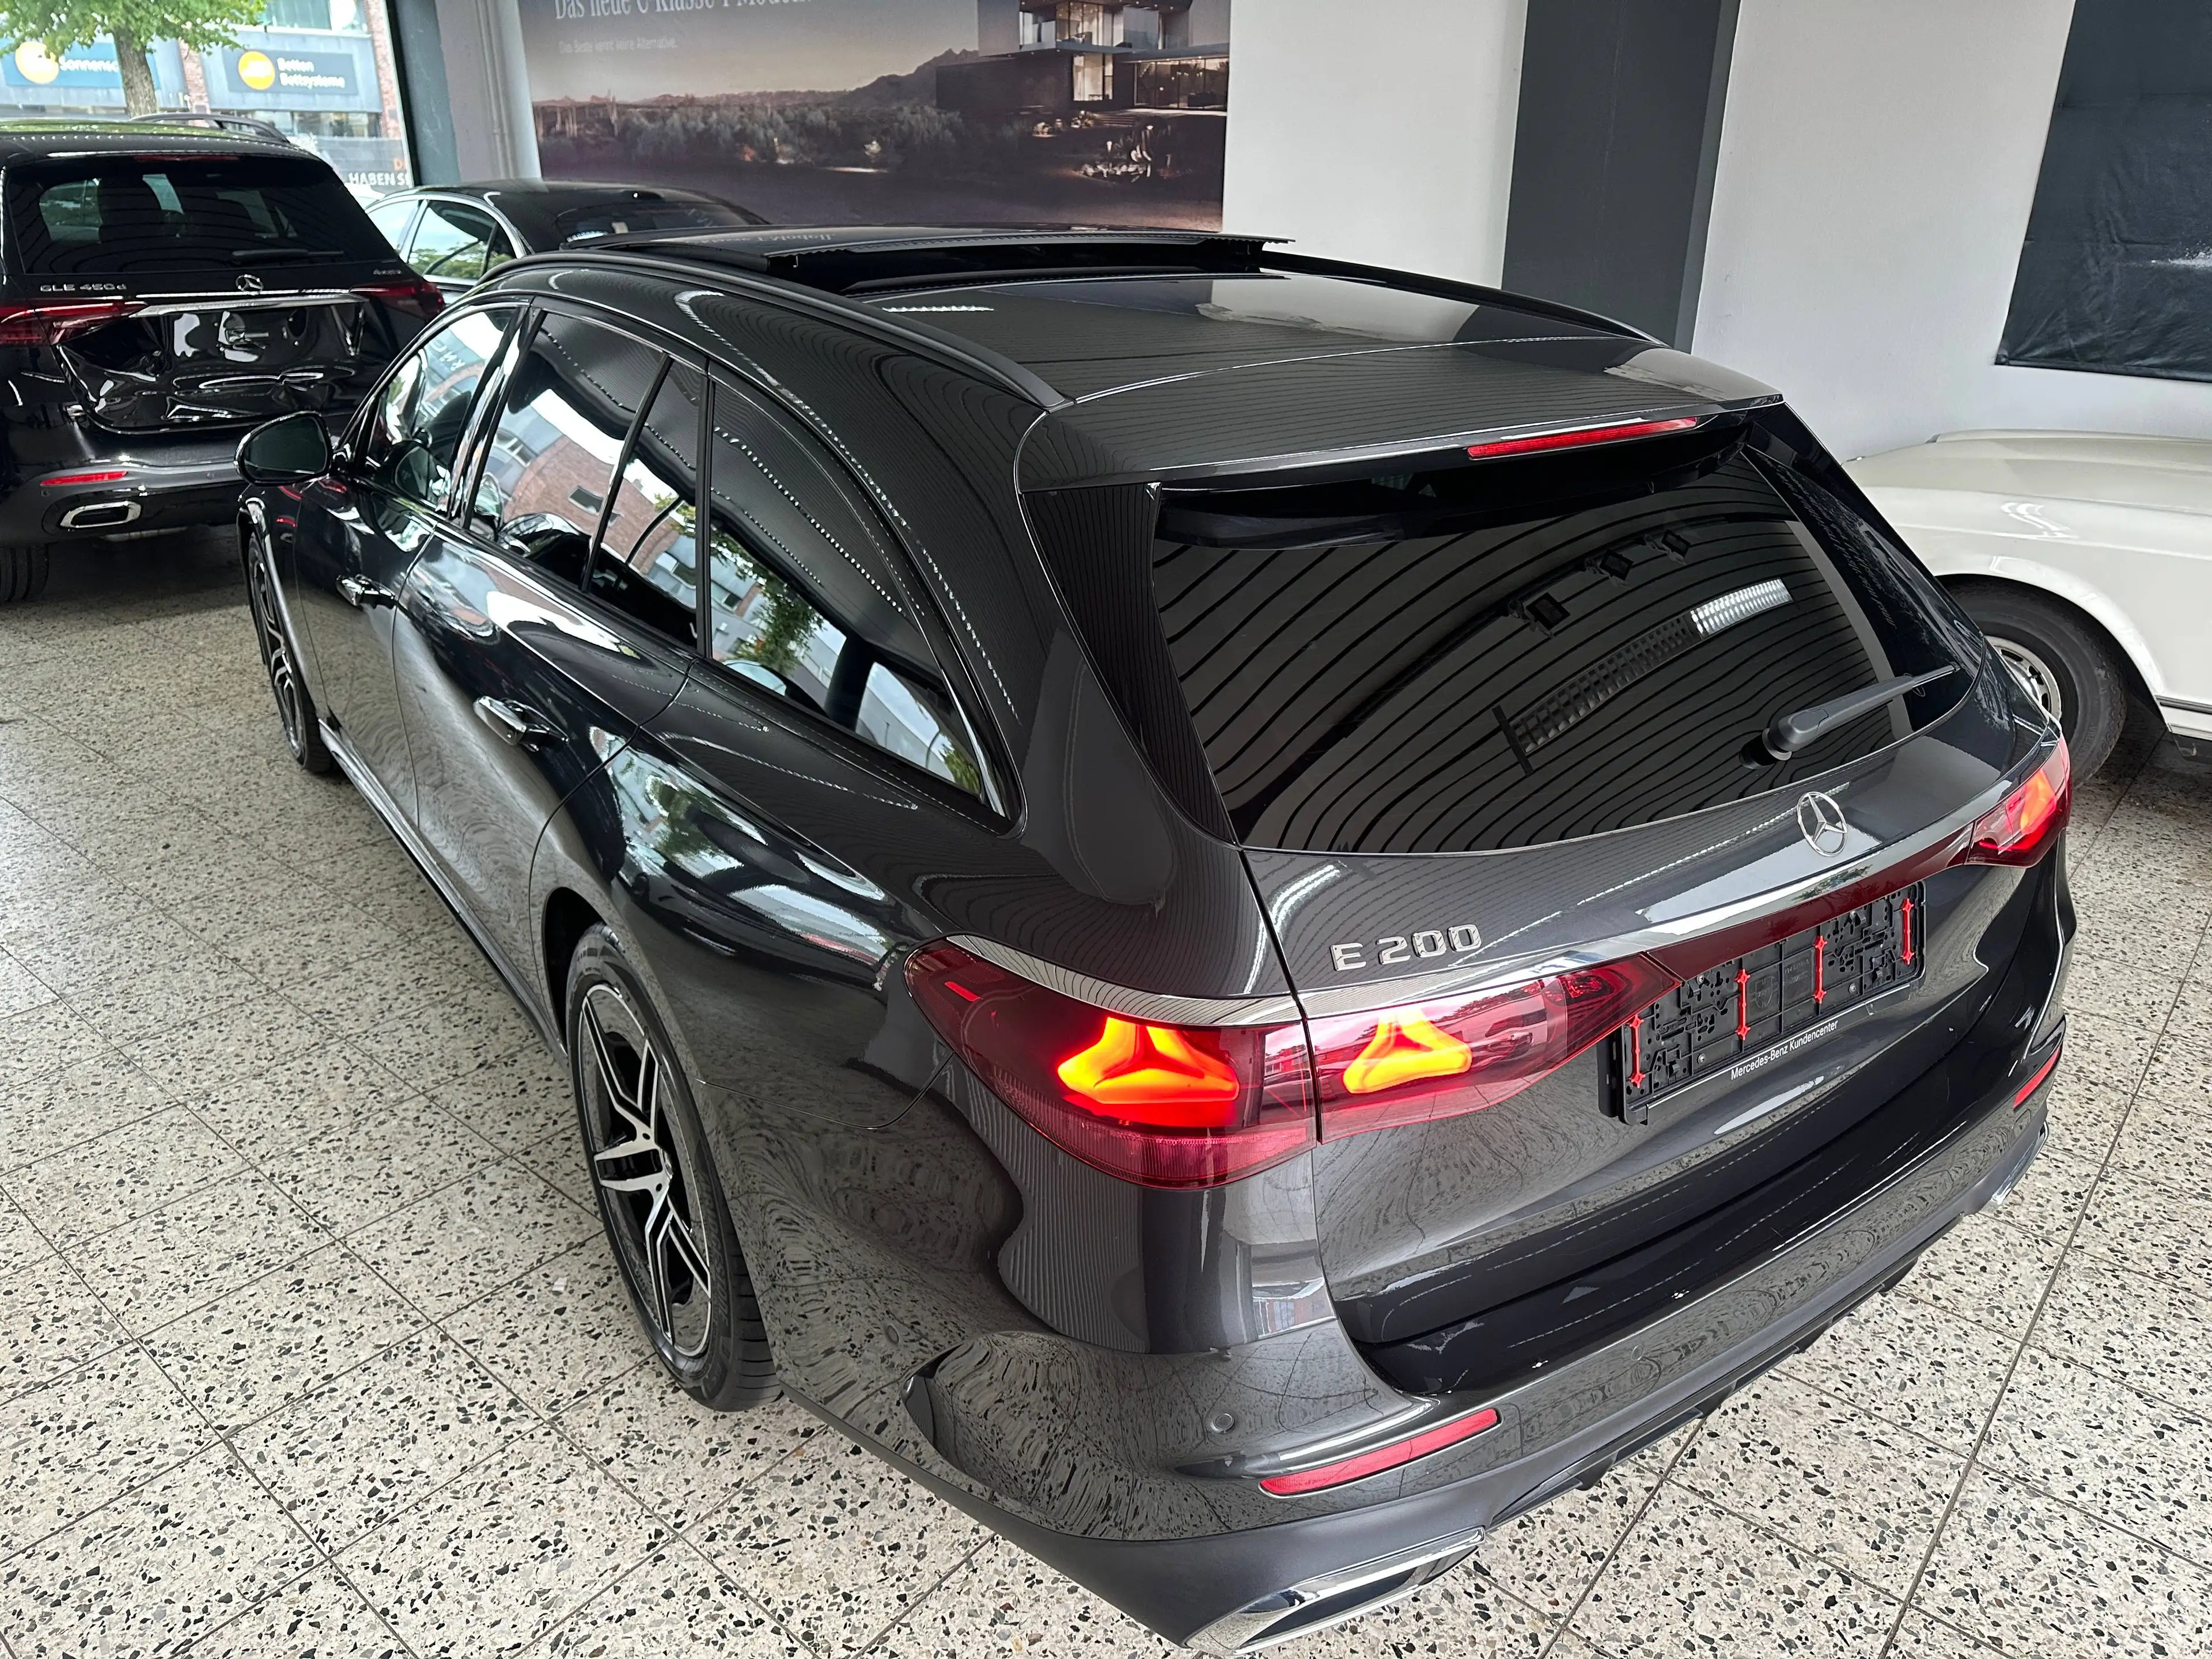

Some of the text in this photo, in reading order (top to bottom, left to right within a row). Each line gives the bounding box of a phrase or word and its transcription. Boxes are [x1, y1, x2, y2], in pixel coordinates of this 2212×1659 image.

[59, 55, 119, 73] Sonnensc
[348, 173, 396, 186] HABEN
[40, 284, 75, 292] GLE
[1330, 924, 1482, 971] E 200
[1731, 1020, 1839, 1080] Mercedes-Benz Kundencenter
